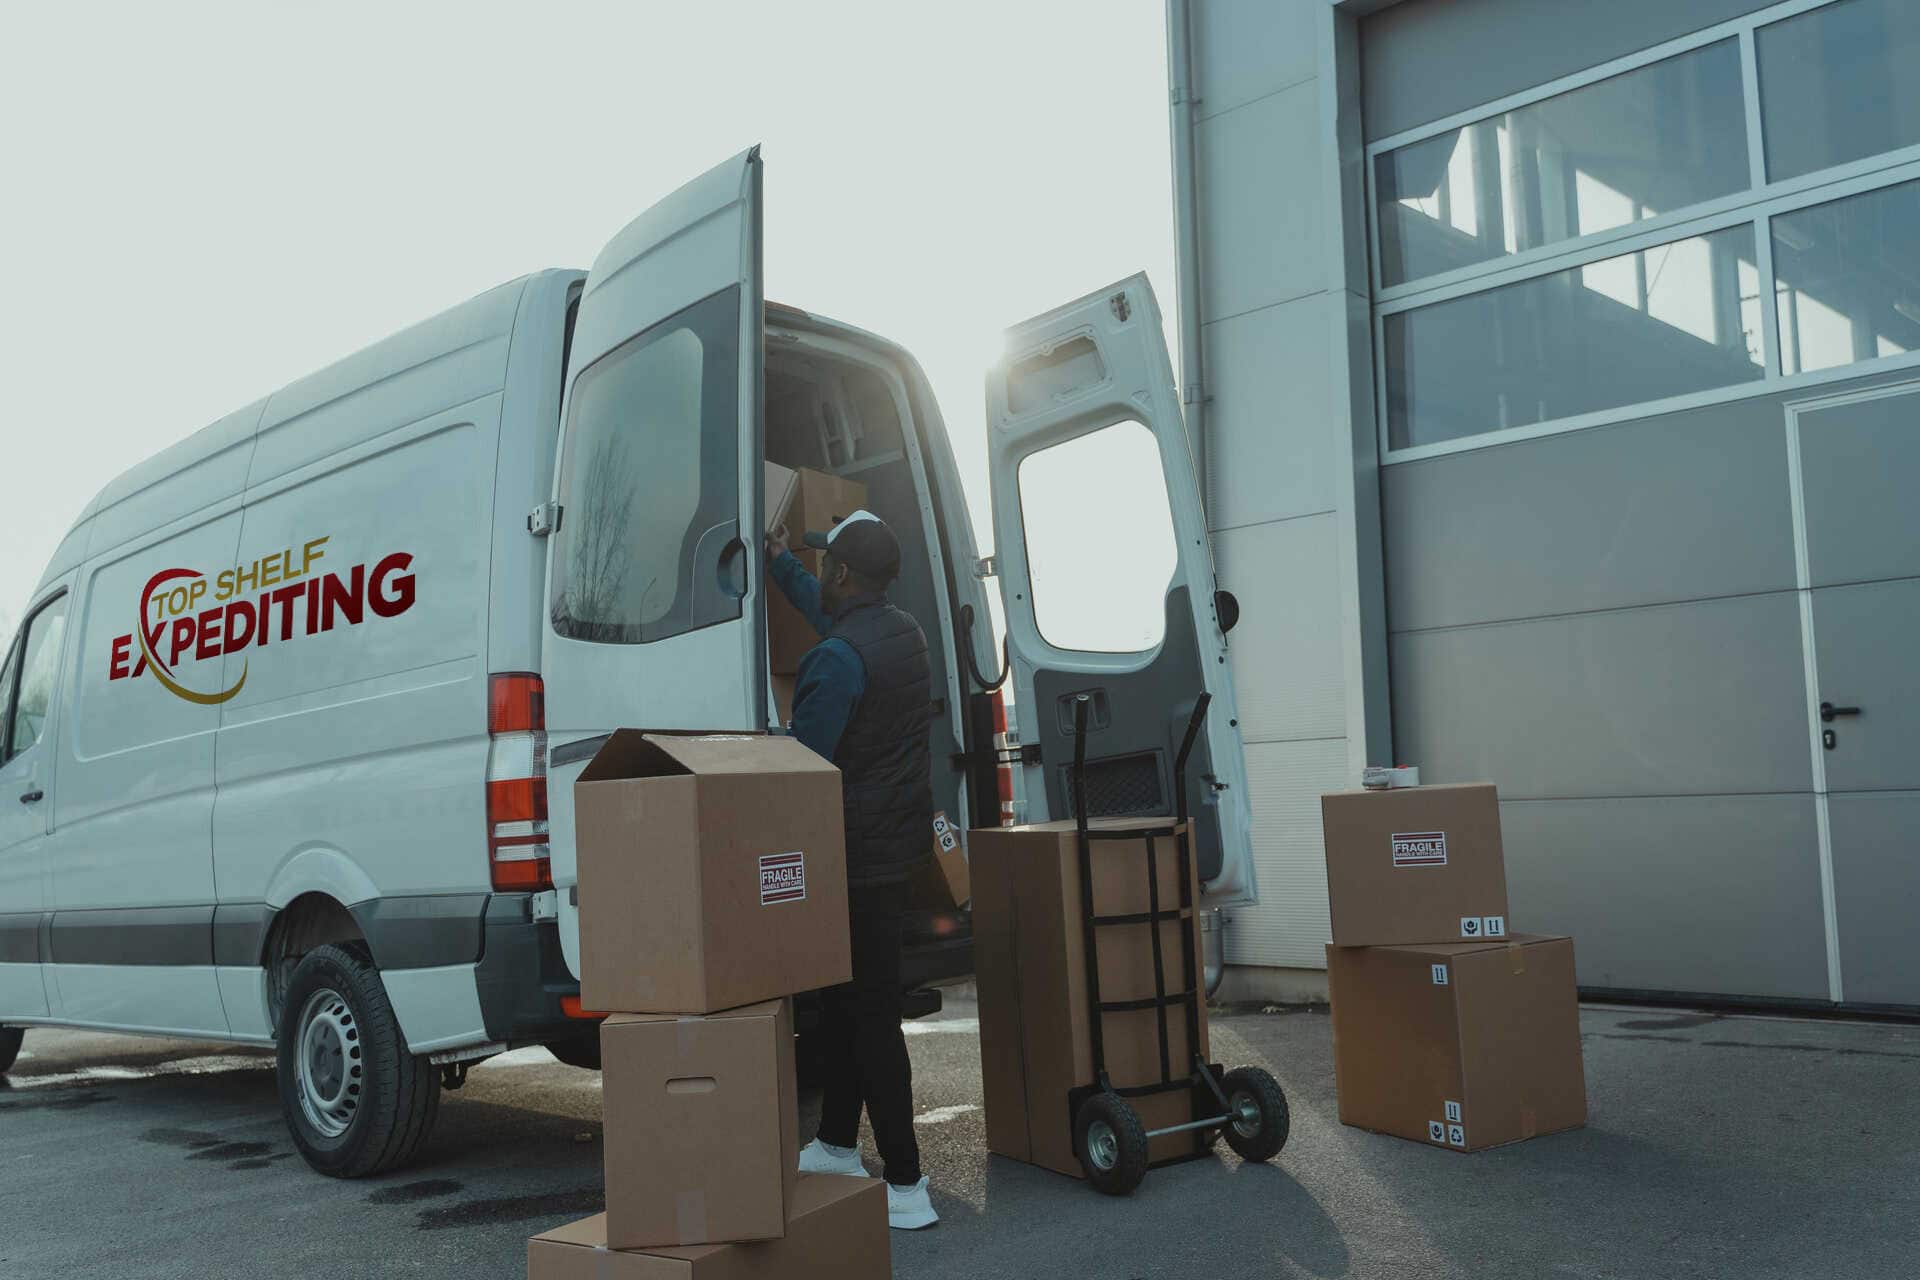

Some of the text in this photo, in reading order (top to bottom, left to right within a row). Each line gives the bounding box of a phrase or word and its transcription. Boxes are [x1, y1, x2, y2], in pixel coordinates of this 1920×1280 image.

[152, 535, 330, 620] TOP SHELF
[109, 552, 416, 681] EXPEDITING
[1394, 841, 1443, 853] FRAGILE
[762, 867, 802, 884] FRAGILE
